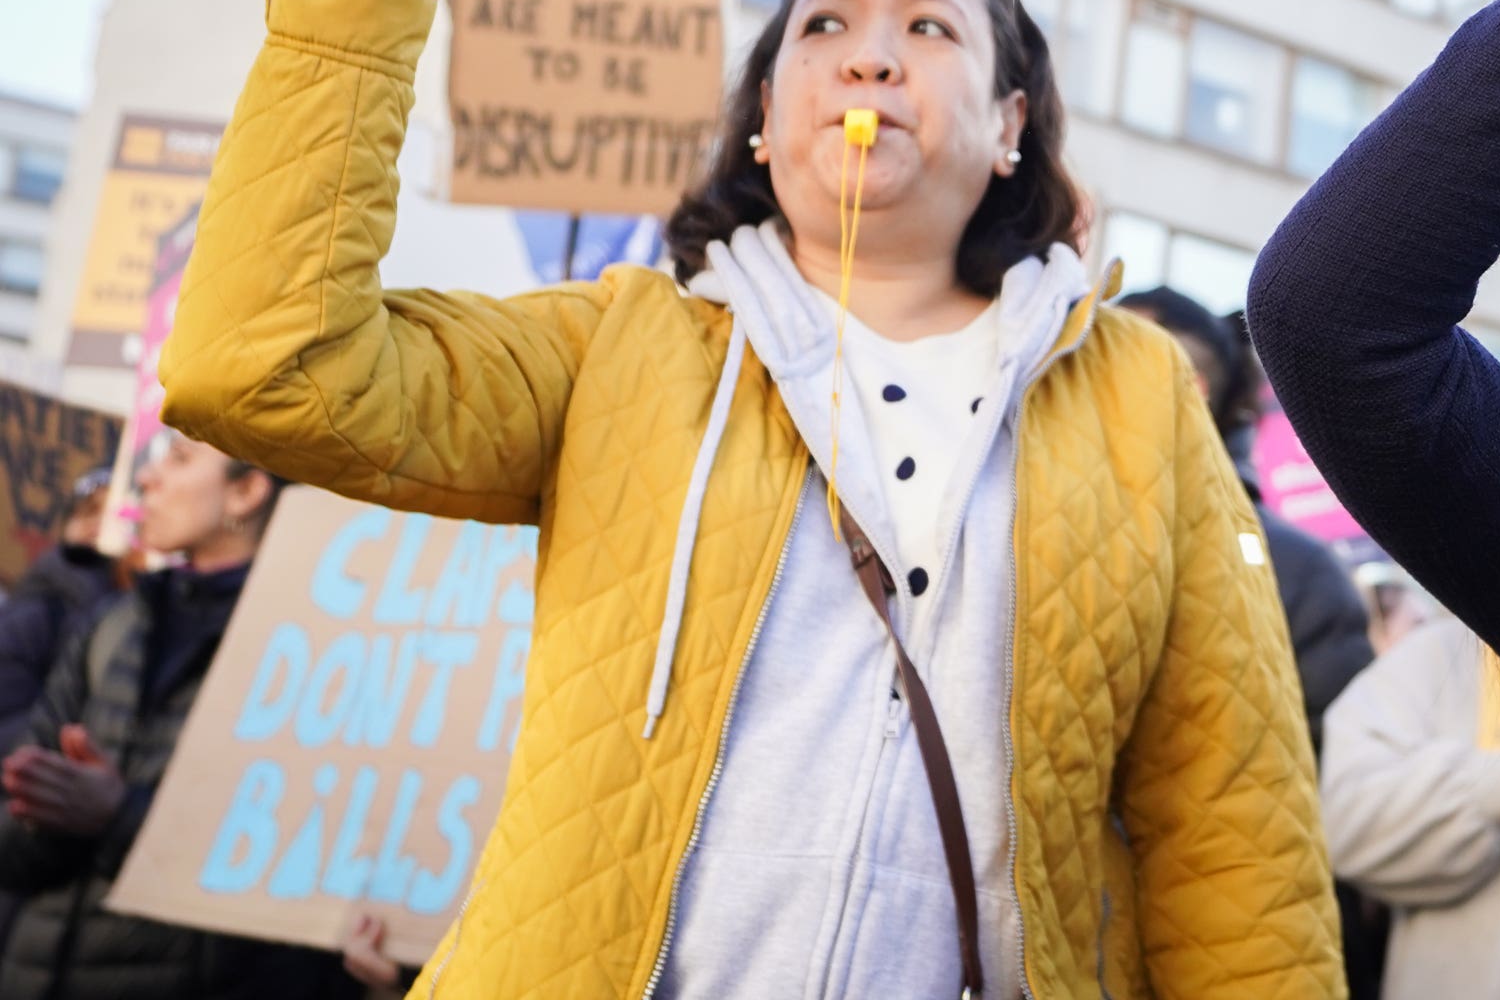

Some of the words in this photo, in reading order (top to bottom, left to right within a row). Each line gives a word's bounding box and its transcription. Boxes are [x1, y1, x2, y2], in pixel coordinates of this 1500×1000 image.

[569, 0, 719, 58] MEANT
[526, 44, 581, 83] TO
[602, 55, 647, 96] BE
